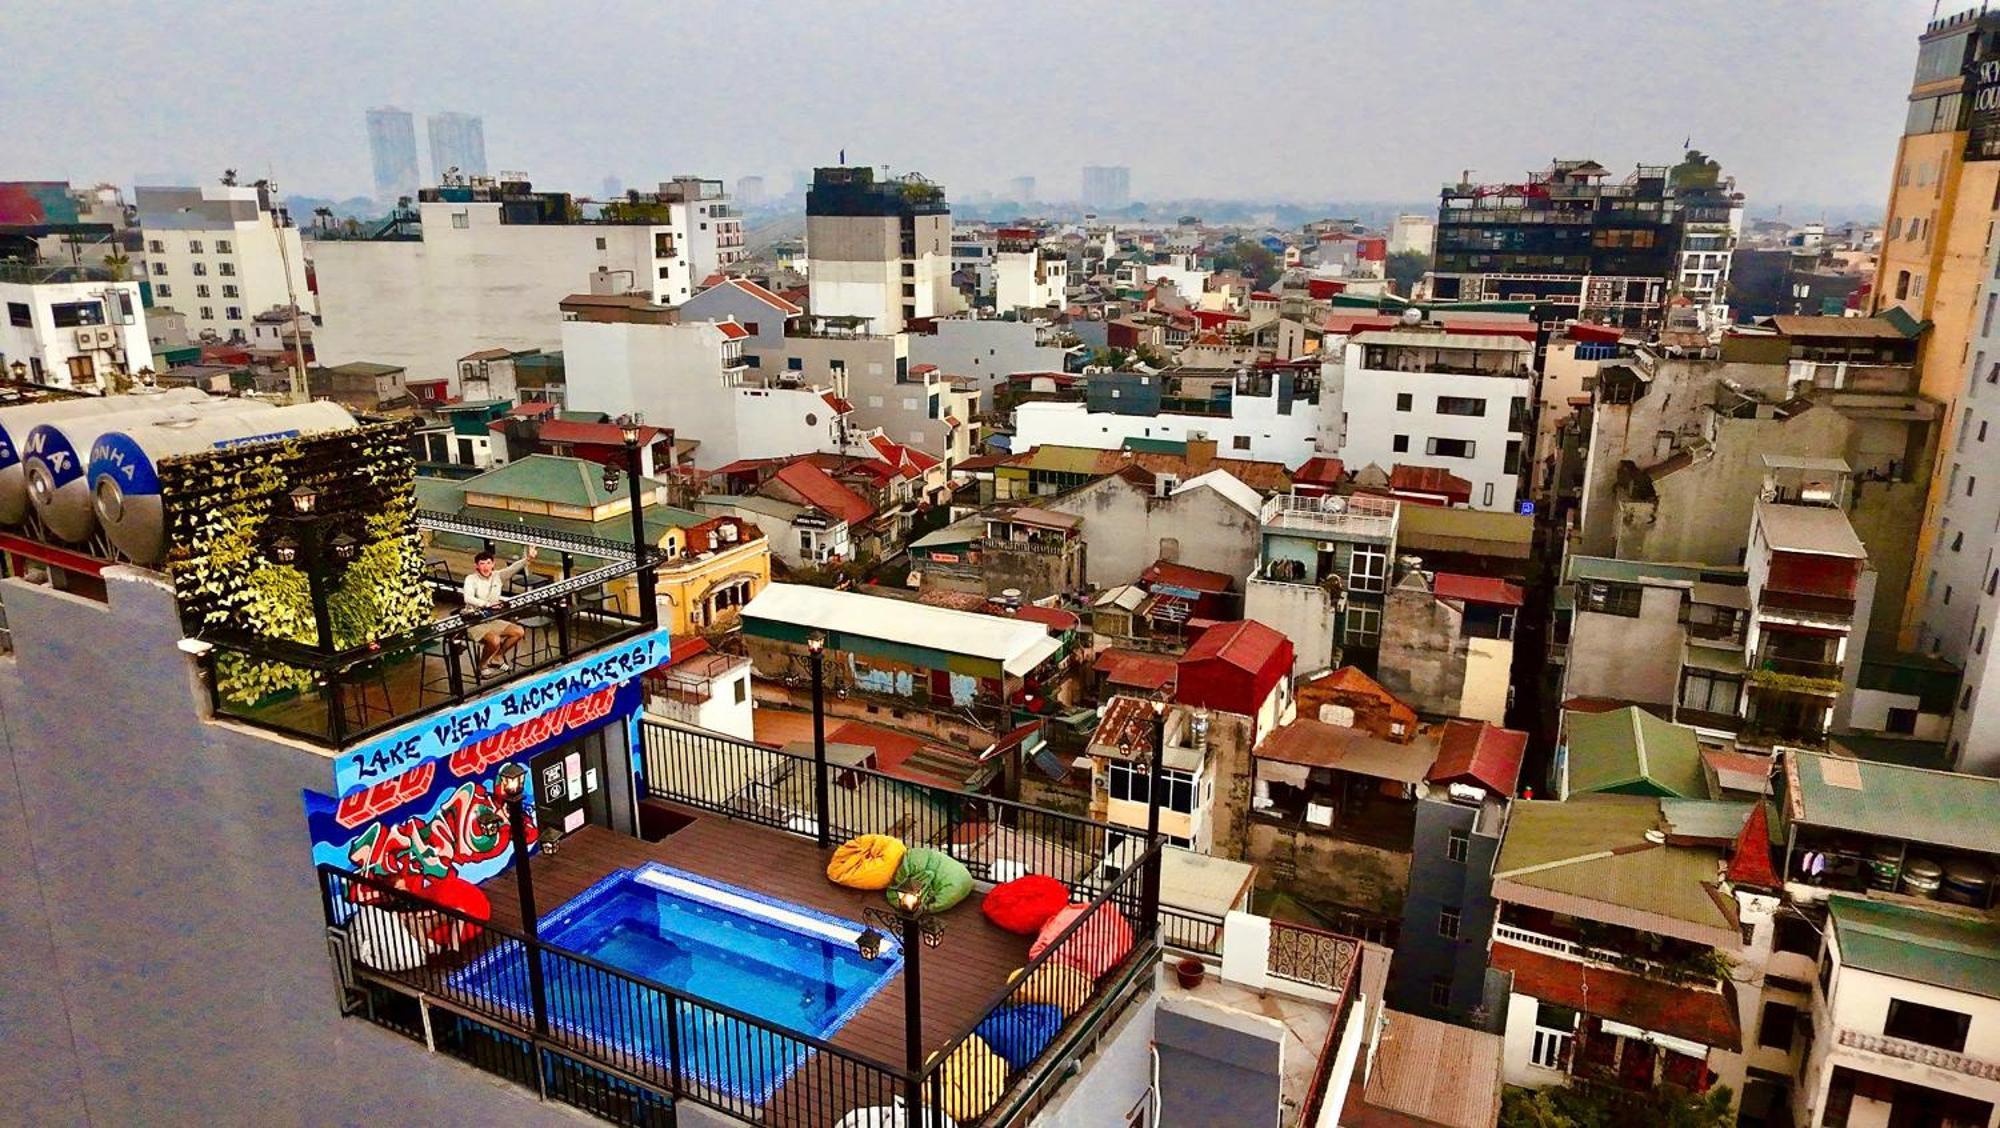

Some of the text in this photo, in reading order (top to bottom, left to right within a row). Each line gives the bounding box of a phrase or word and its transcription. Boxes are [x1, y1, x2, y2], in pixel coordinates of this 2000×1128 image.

[351, 639, 655, 780] LAKE VIEW BACKPACKERS!
